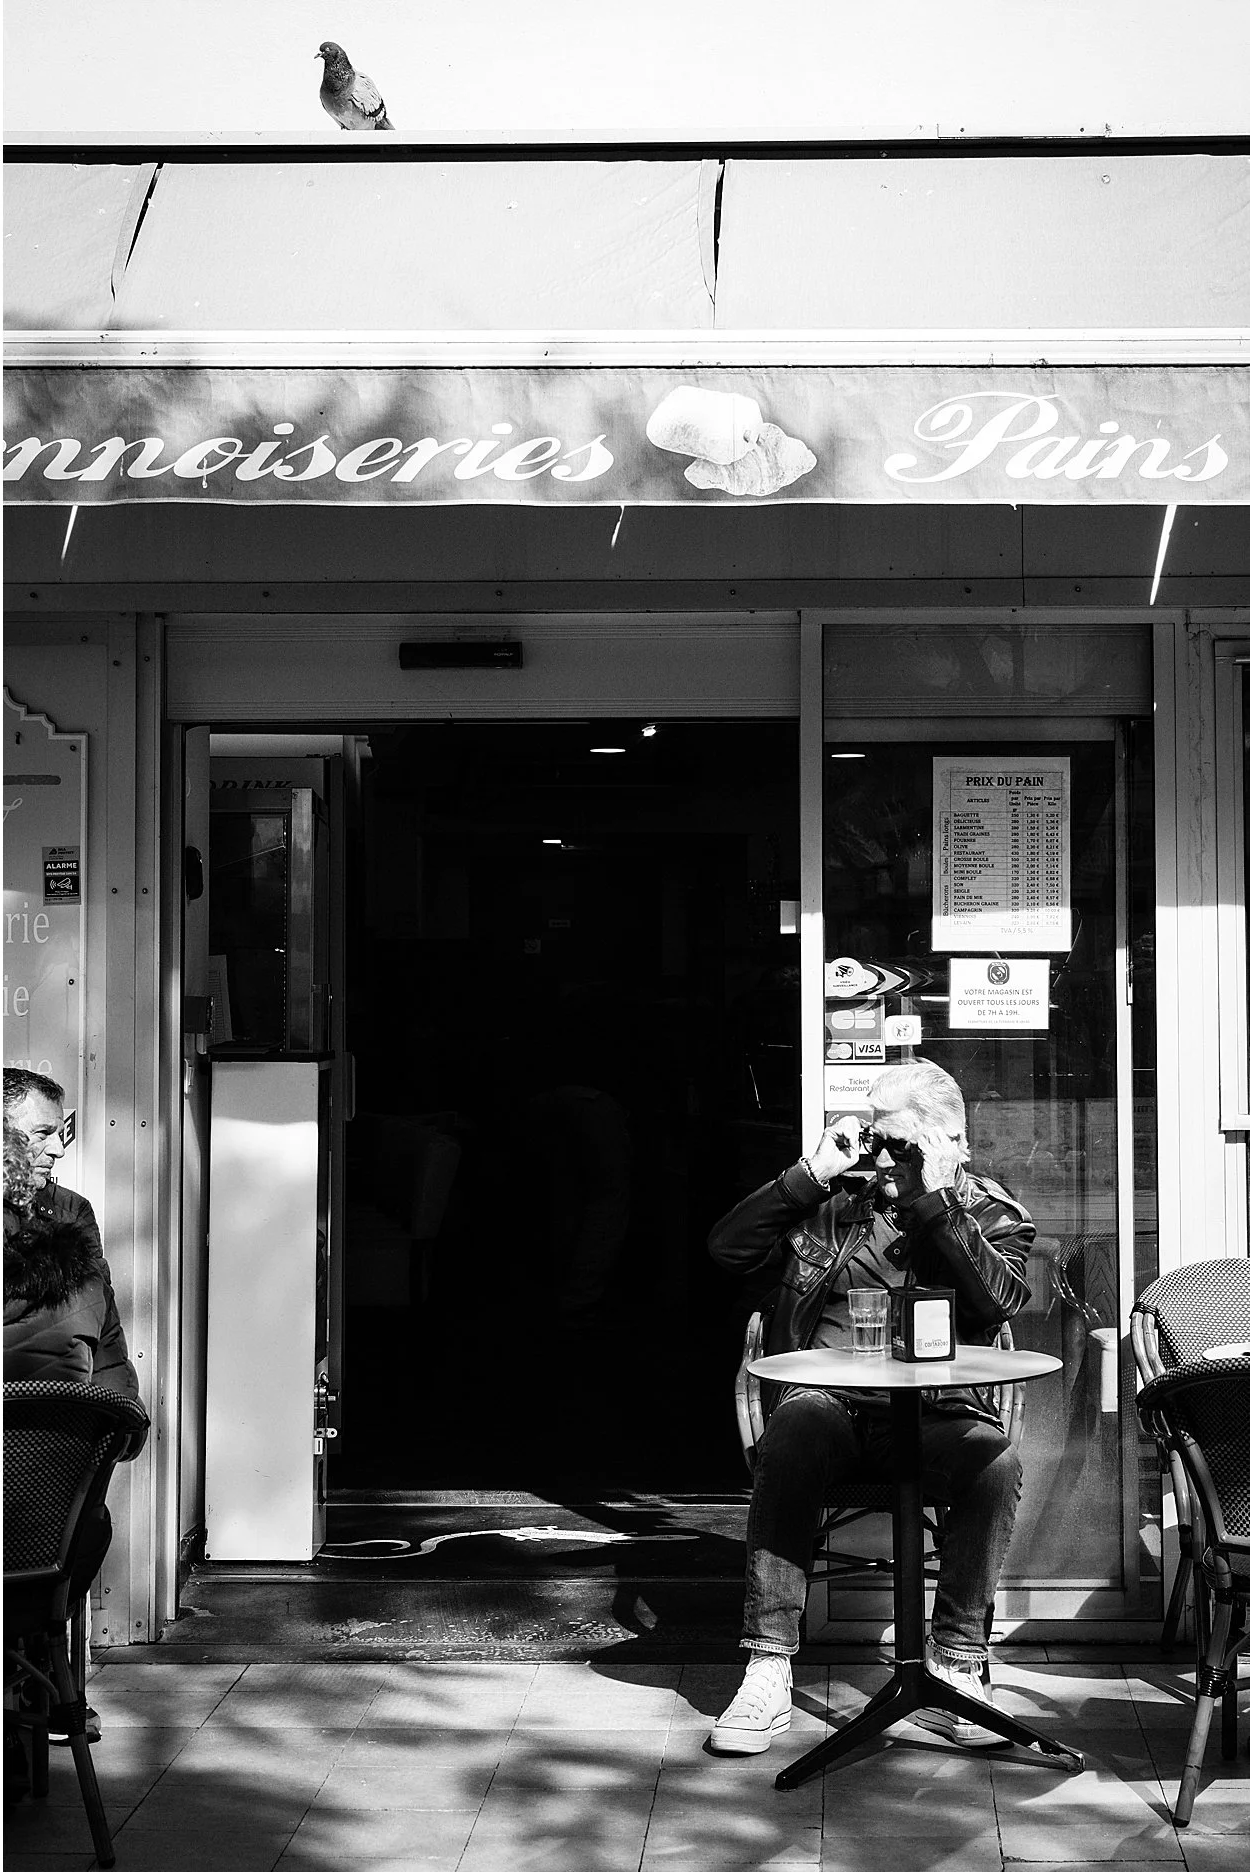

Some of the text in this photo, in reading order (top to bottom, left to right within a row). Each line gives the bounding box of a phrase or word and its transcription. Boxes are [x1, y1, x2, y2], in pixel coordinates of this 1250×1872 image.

[3, 391, 1229, 484] nnoiseries Pains
[965, 776, 1044, 786] PRIX DU PAIN
[942, 817, 950, 834] longs
[5, 902, 50, 944] rie
[858, 1044, 882, 1054] VISA
